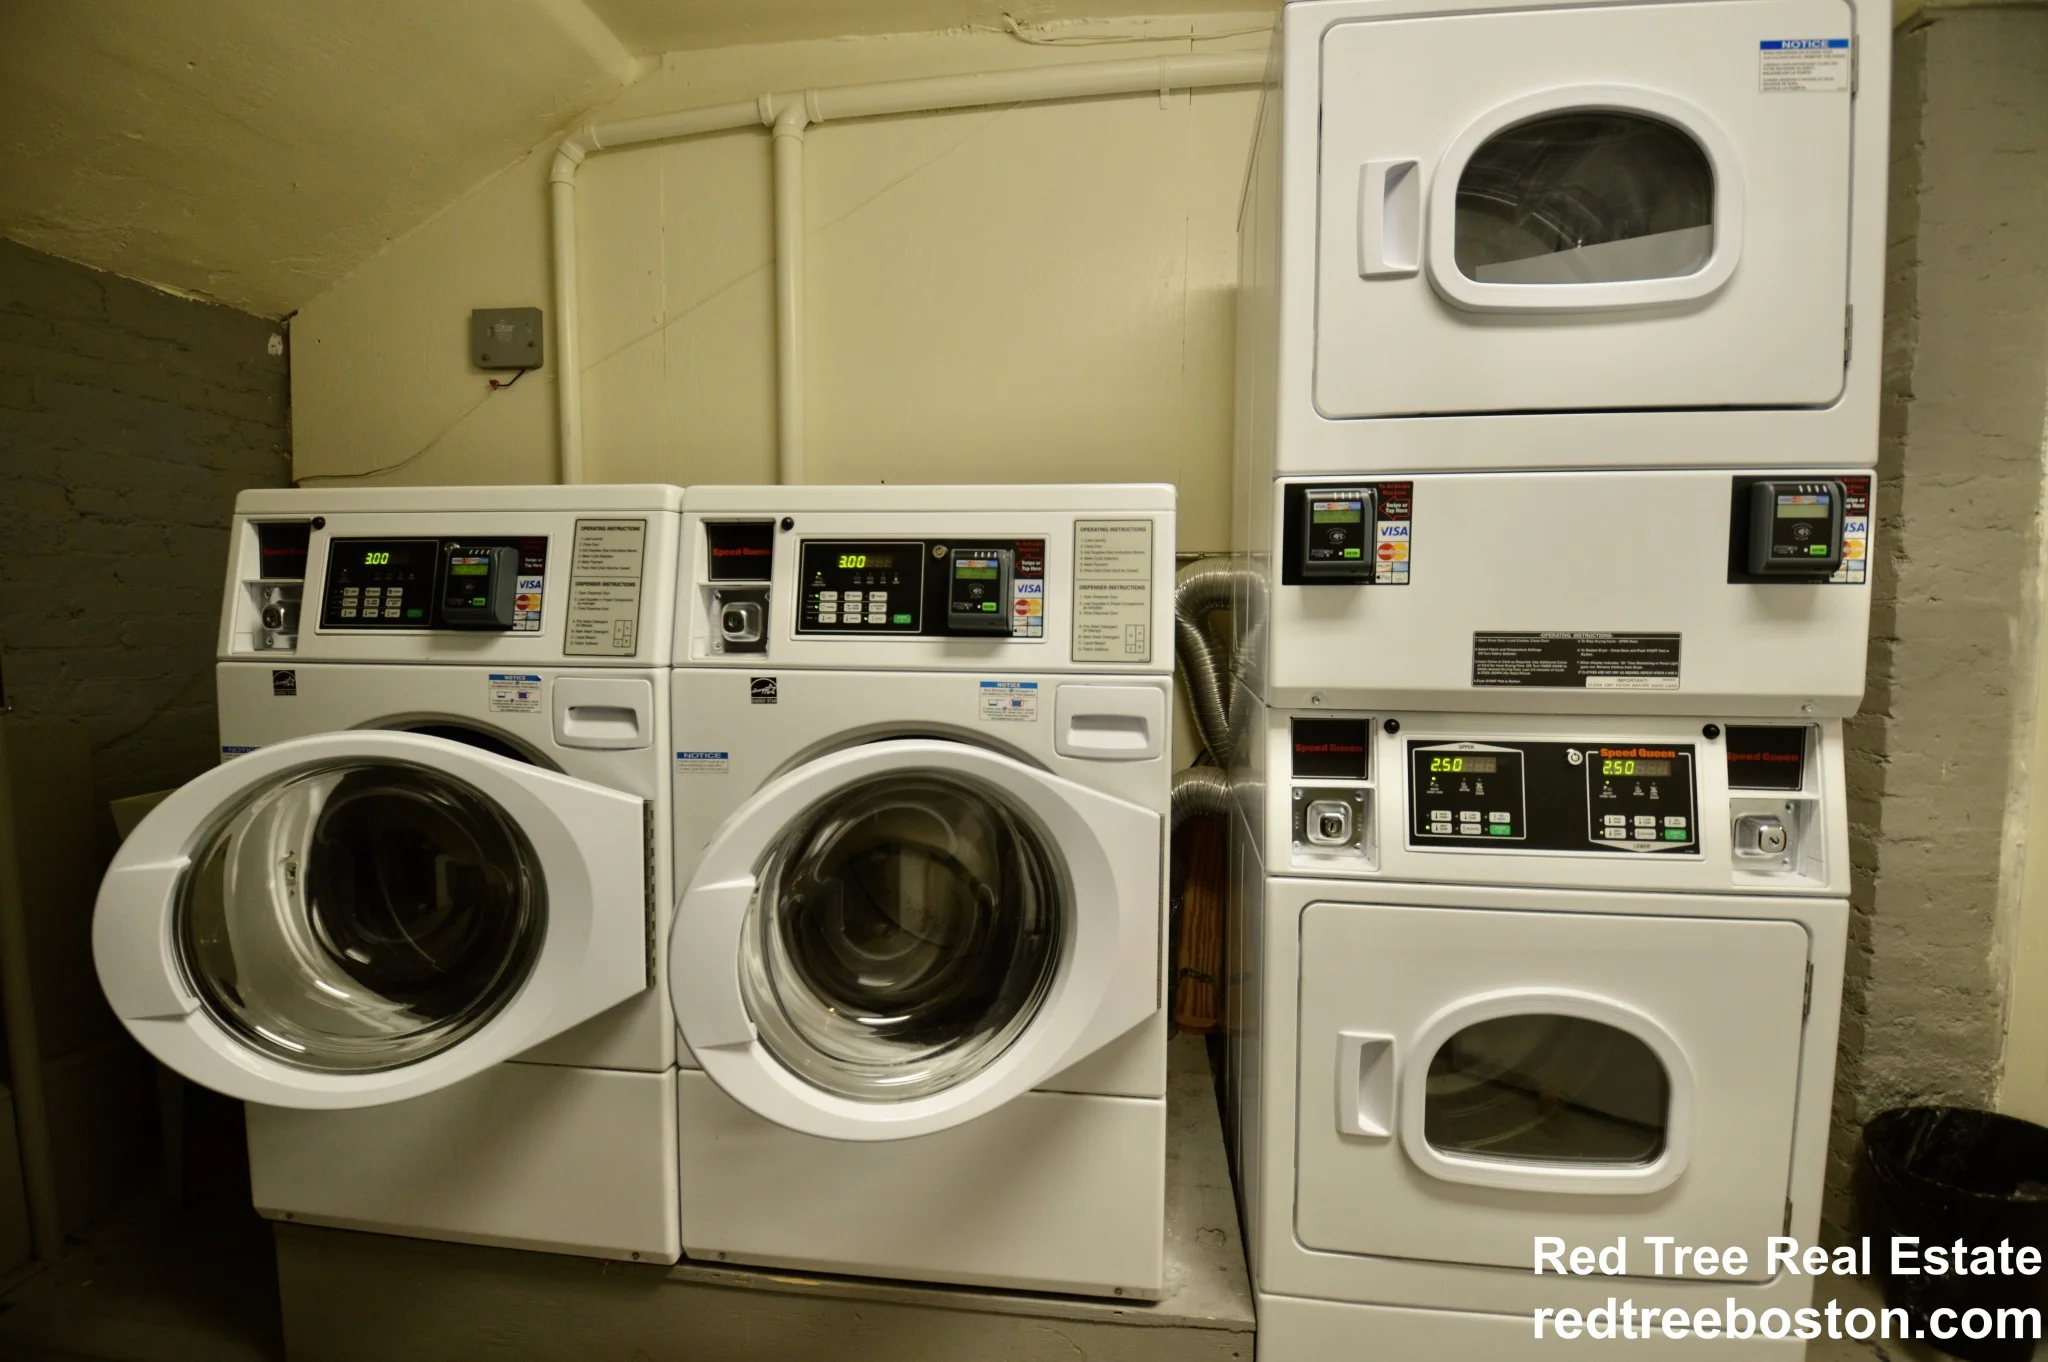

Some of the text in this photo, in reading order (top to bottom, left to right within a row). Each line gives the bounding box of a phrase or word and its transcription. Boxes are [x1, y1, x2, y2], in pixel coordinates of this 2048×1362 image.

[1781, 39, 1827, 49] NOTICE
[1381, 526, 1408, 536] VISA
[1844, 522, 1865, 533] ISA
[364, 552, 390, 565] 3.00
[838, 555, 866, 568] 3.00
[520, 580, 541, 588] VISA
[1018, 584, 1041, 593] VISA
[1600, 748, 1676, 759] Speed Queen
[1430, 757, 1463, 772] 2.50
[1602, 760, 1635, 775] 2.50
